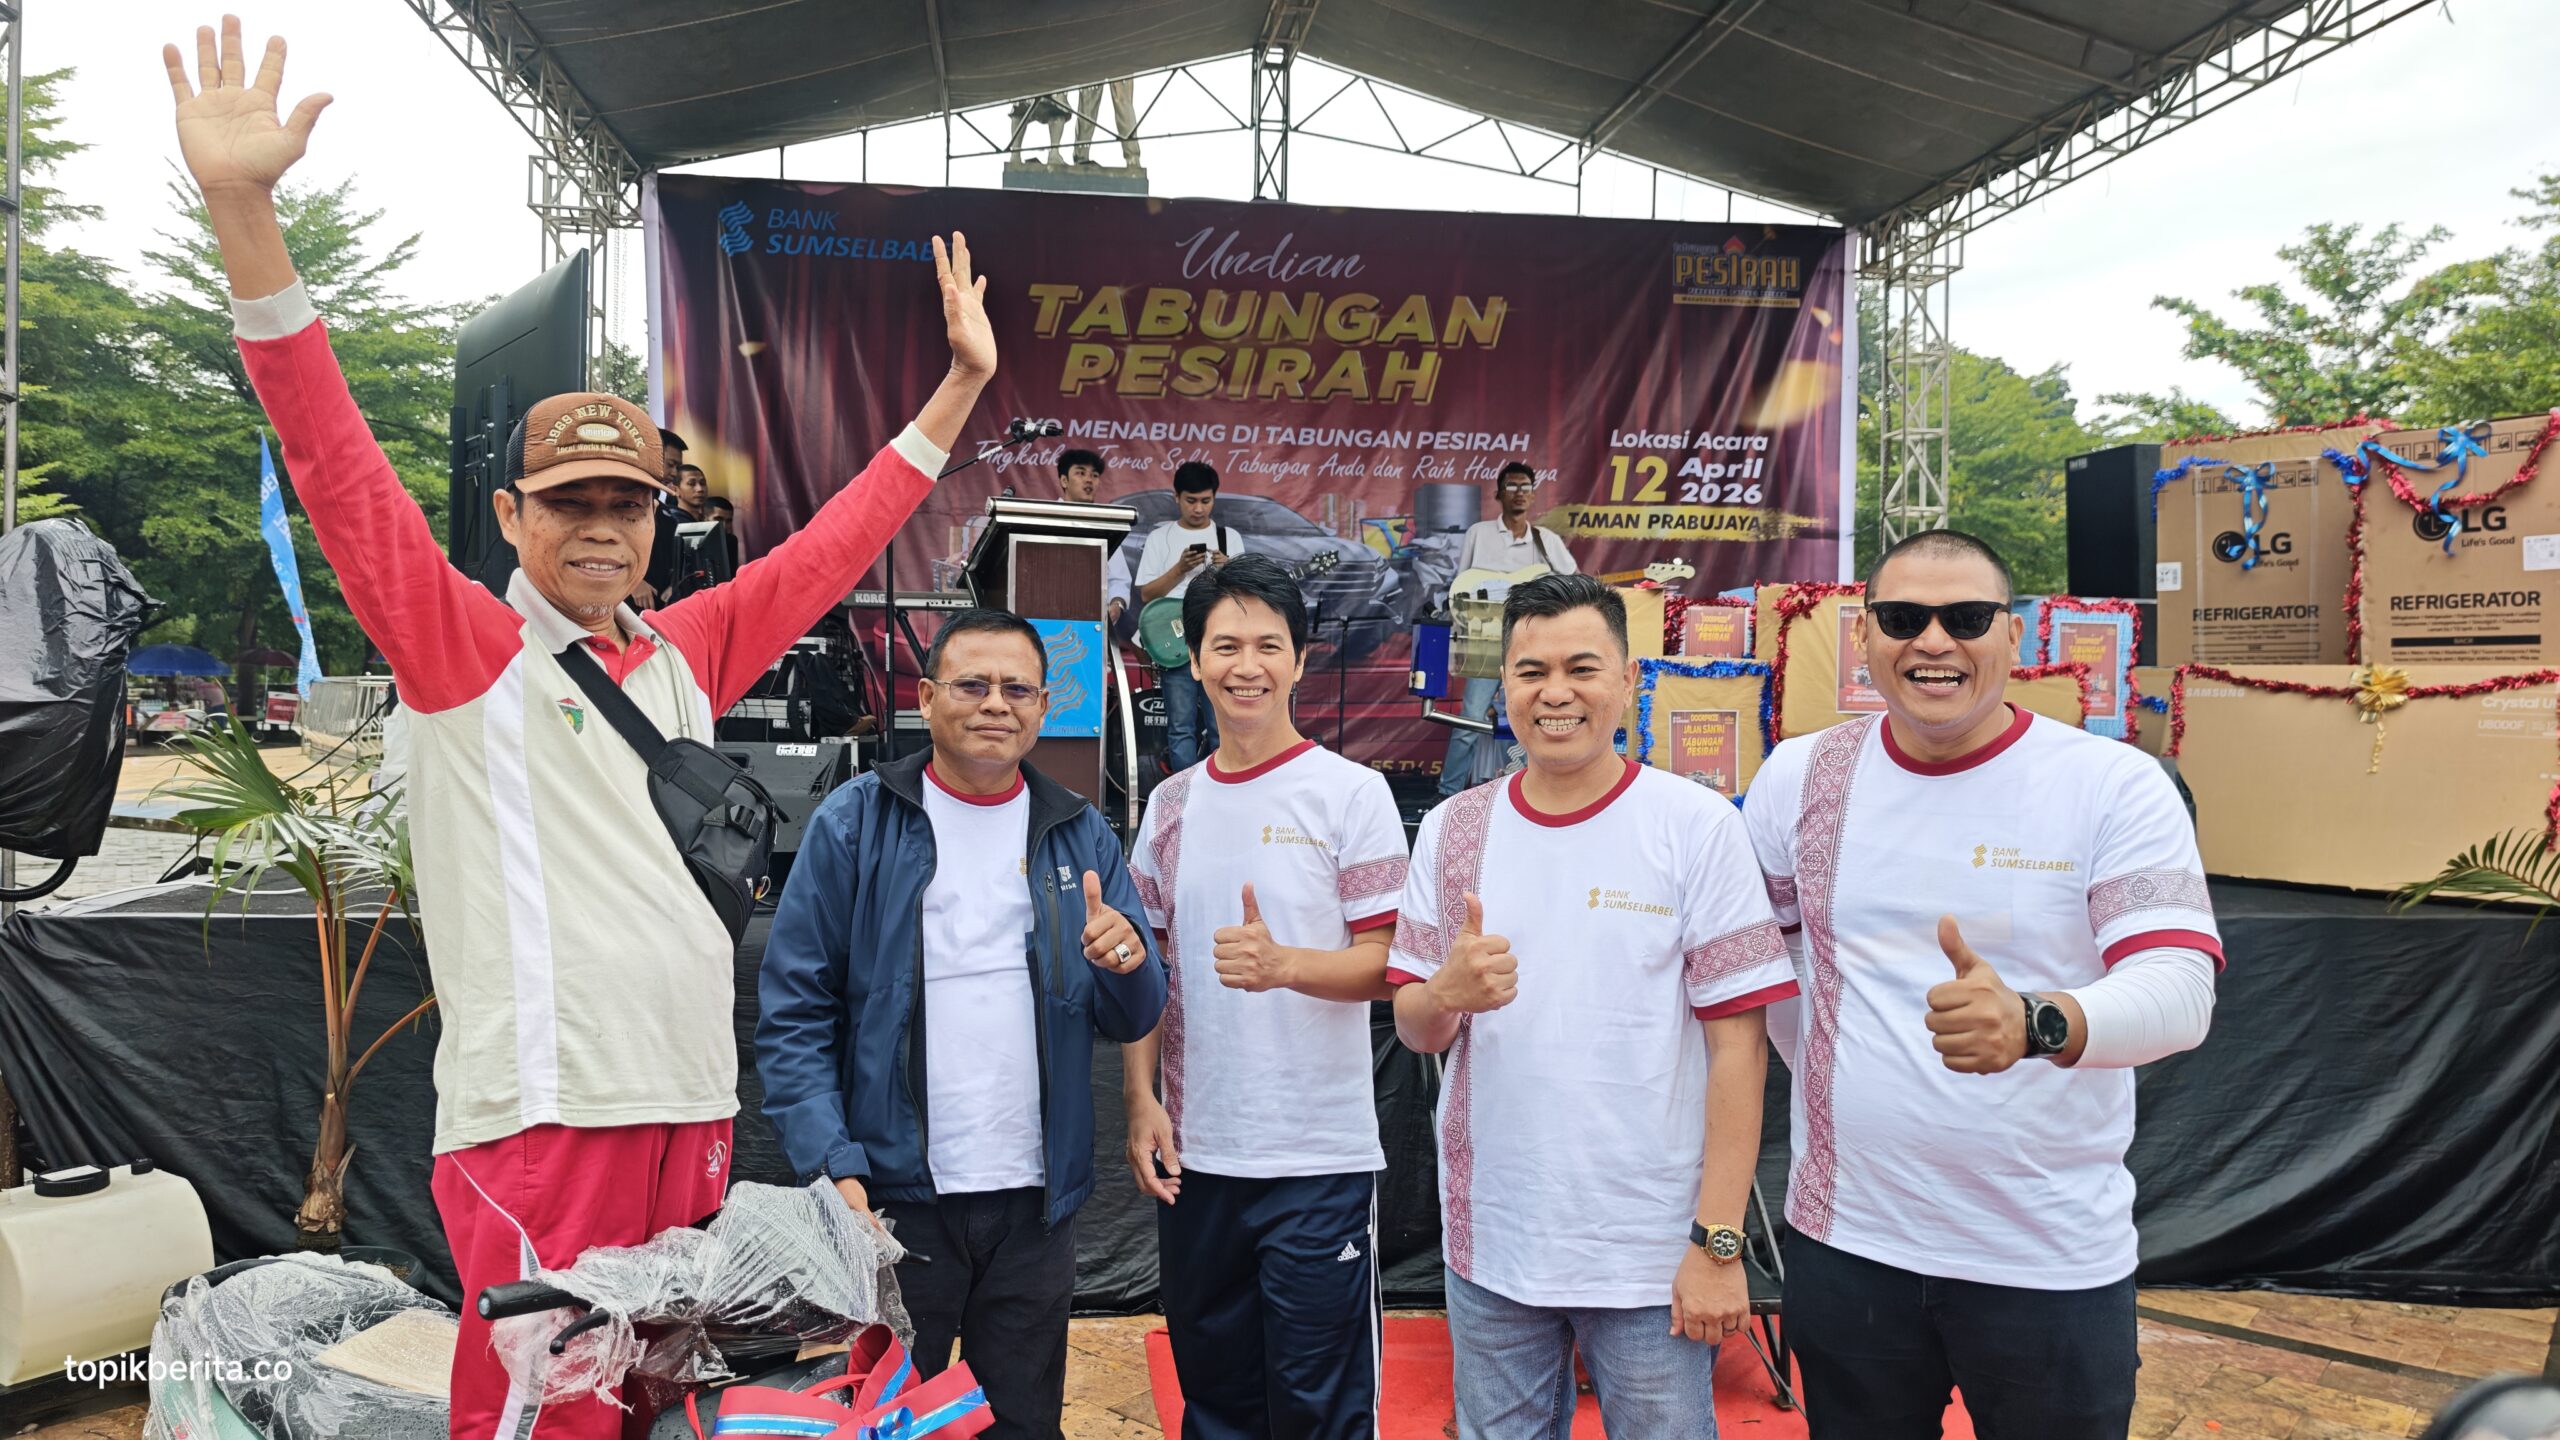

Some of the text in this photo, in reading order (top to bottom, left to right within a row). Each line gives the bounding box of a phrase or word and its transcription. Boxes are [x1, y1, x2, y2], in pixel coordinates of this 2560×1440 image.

[767, 208, 840, 231] BANK
[766, 234, 952, 262] SUMSELBAB
[1175, 226, 1366, 282] Undian
[1674, 252, 1799, 289] PESIRAH
[1028, 283, 1508, 350] TABUNGAN
[1059, 343, 1442, 406] PESIRAH
[545, 404, 646, 448] 1989 NEW YORK
[1067, 419, 1226, 443] MENABUNG
[1232, 425, 1261, 444] DI
[1265, 426, 1412, 449] TABUNGAN
[1416, 431, 1530, 452] PESIRAH
[1610, 429, 1768, 451] Lokasi Acara
[1225, 449, 1309, 482] Tabungan
[1317, 452, 1365, 478] Anda
[1373, 457, 1402, 478] dan
[1412, 455, 1454, 480] Raih
[1463, 455, 1558, 490] Hadya
[1610, 455, 1669, 502] 12
[1677, 457, 1763, 483] April
[1680, 482, 1763, 504] 2026
[1568, 511, 1761, 531] TAMAN PRABUJAYA
[2462, 506, 2507, 533] LG
[2253, 532, 2292, 556] LG
[2461, 536, 2515, 547] Life's Good
[855, 593, 886, 603] KORG
[2390, 591, 2541, 611] REFRIGERATOR
[2192, 605, 2319, 621] REFRIGERATOR
[2185, 687, 2245, 698] SAMSUNG
[2481, 696, 2540, 711] Crystal
[1275, 826, 1297, 834] BANK
[1275, 835, 1332, 851] SUMSELBABEL
[1992, 847, 2021, 857] BANK
[1991, 858, 2076, 872] SUMSELBABEL
[1604, 889, 1630, 899] BANK
[1603, 900, 1674, 916] SUMSELBABEL
[1337, 1249, 1360, 1261] adidas
